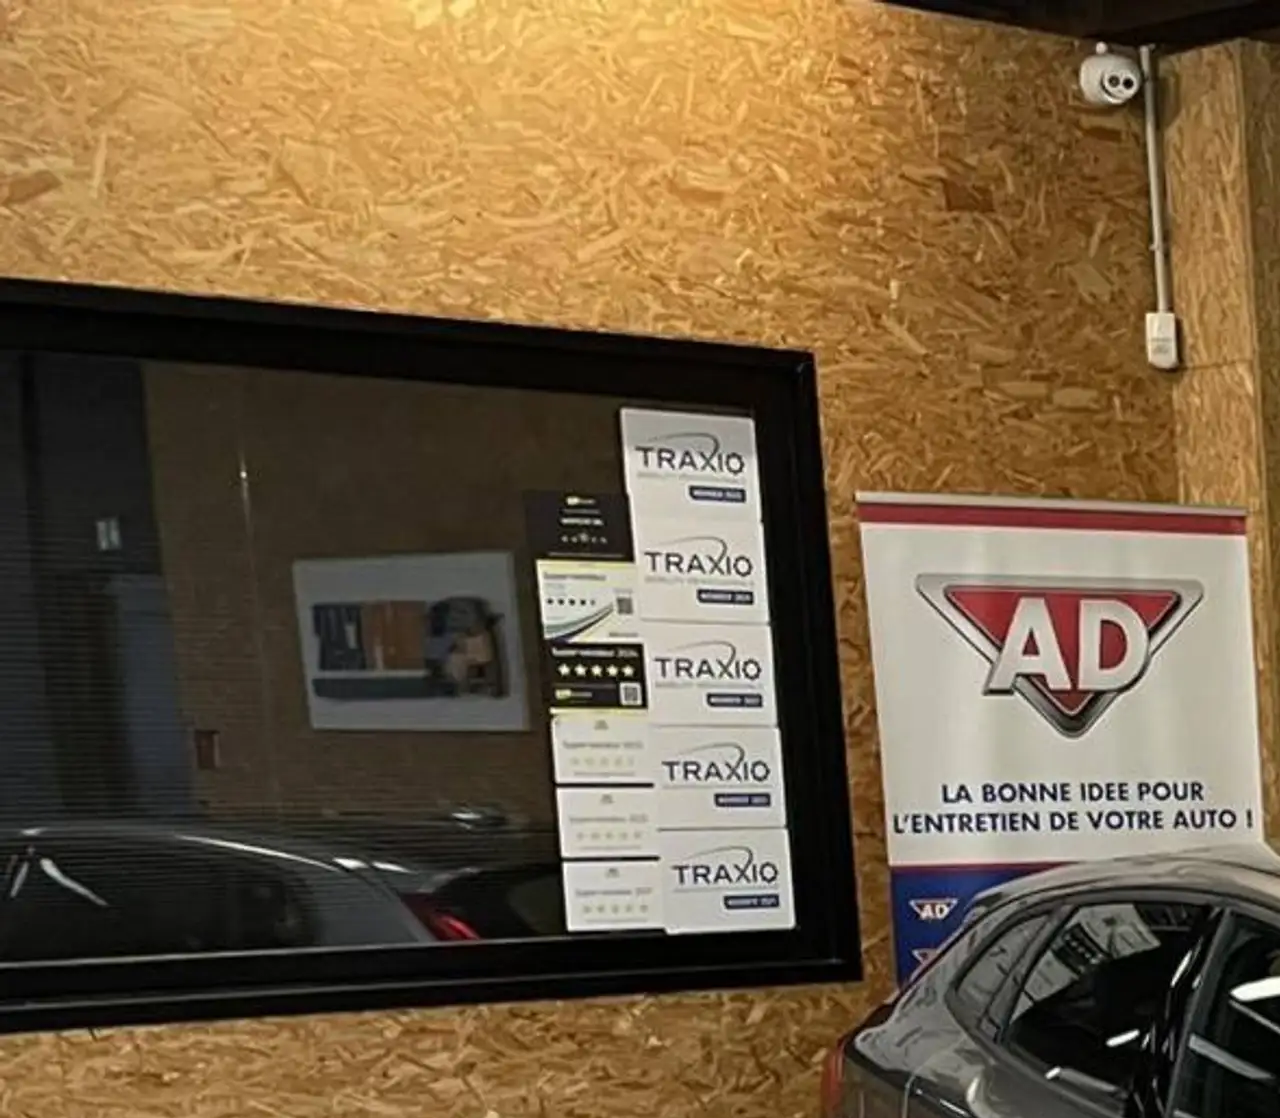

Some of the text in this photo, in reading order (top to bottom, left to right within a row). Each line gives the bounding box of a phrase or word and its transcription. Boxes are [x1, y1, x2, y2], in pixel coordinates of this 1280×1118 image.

[635, 445, 745, 475] TRAXIO
[643, 550, 754, 577] TRAXIO
[985, 597, 1150, 694] AD
[653, 657, 762, 681] TRAXIO
[661, 759, 771, 782] TRAXIO
[942, 781, 1204, 803] LA BONNE IDEE POUR
[893, 811, 1041, 834] L'ENTRETIEN
[1050, 811, 1080, 831] DE
[1086, 809, 1165, 830] VOTRE
[1173, 808, 1237, 829] AUTO
[671, 861, 778, 885] TRAXIO
[920, 904, 949, 920] AD
